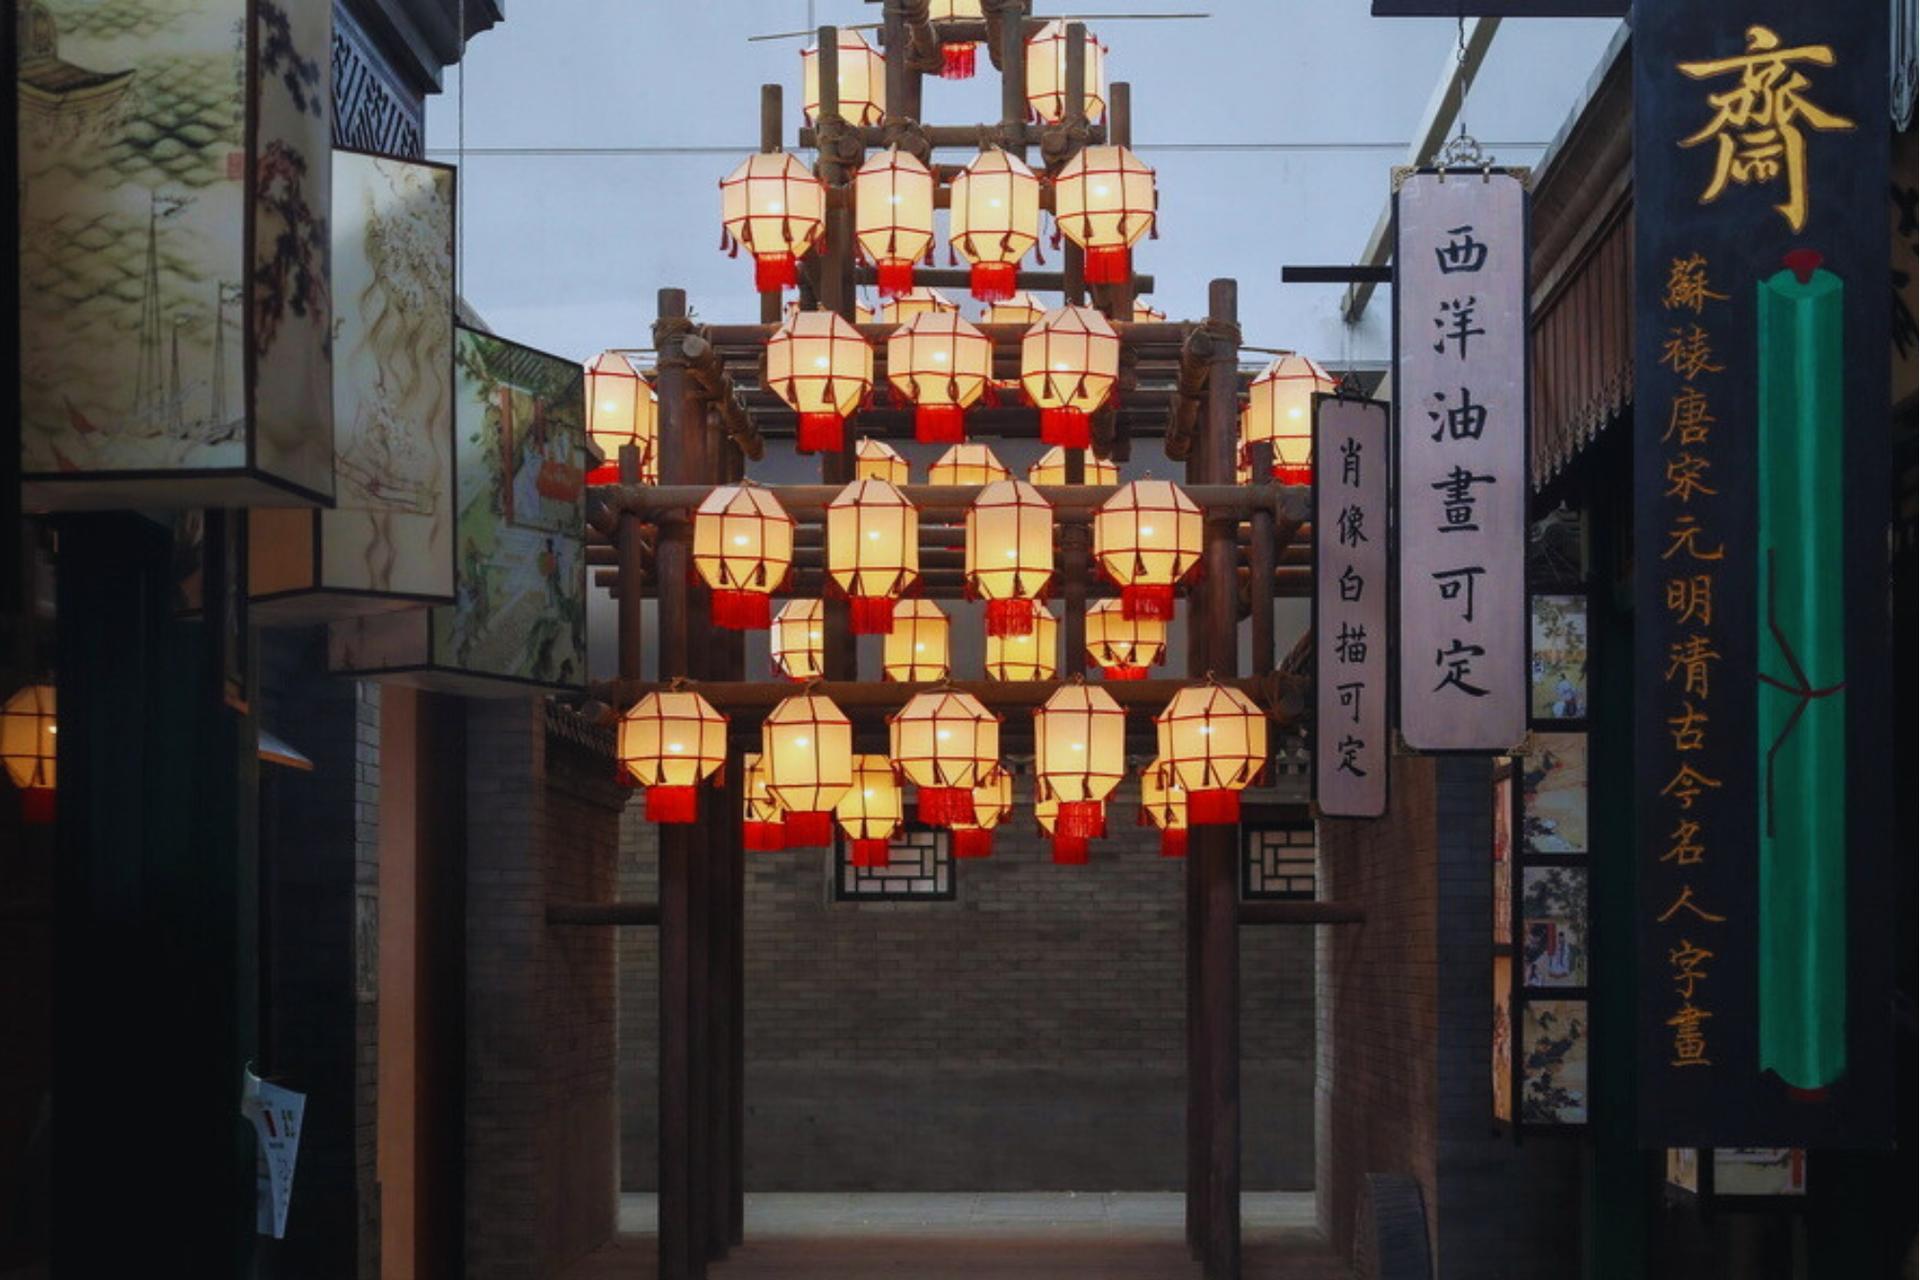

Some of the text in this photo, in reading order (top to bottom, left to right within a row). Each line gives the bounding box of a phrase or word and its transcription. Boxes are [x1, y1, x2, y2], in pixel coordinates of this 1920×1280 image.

[1676, 25, 1856, 233] 齋
[1334, 436, 1370, 779] 肖像白描可定
[1429, 226, 1497, 698] 西洋油畫可定
[1657, 253, 1729, 1068] 蘇裱唐宋元明清古今名人字畫
